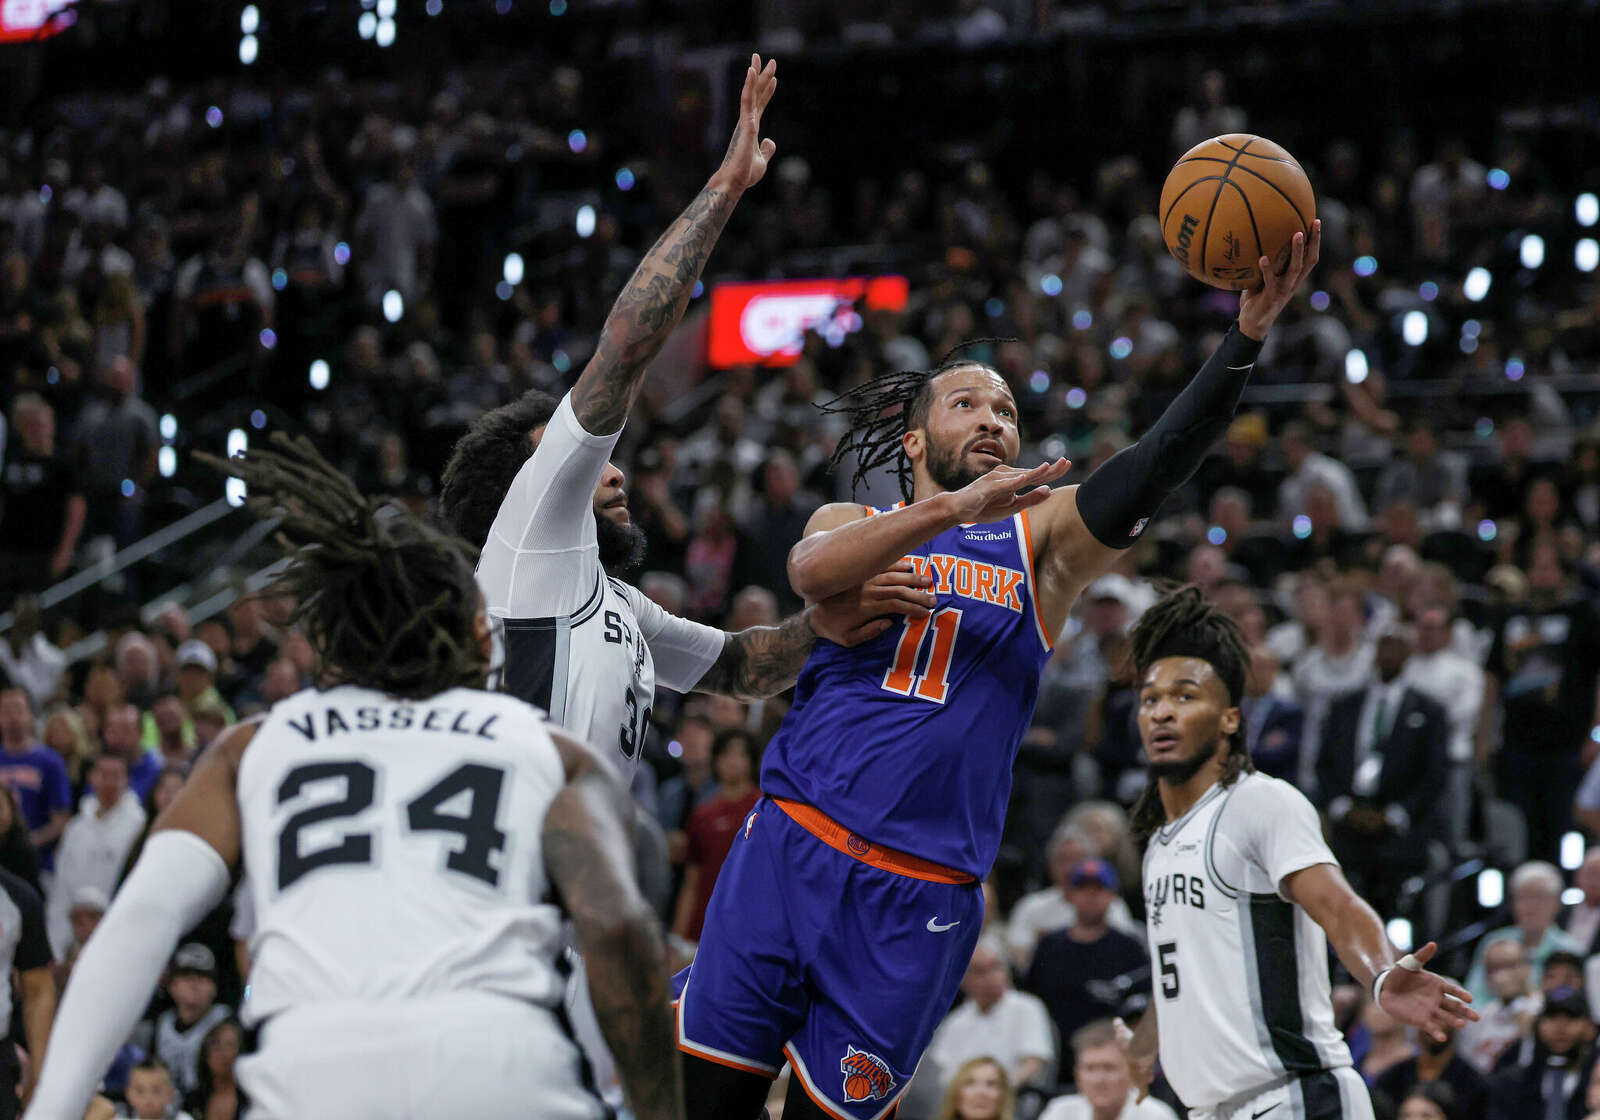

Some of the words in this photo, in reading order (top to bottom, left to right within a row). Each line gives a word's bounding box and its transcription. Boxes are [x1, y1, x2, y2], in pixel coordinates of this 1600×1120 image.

[964, 533, 983, 541] abu
[984, 529, 1012, 541] dhabi
[929, 553, 1026, 615] YORK
[880, 606, 964, 705] 11
[287, 707, 499, 742] VASSELL
[275, 759, 510, 893] 24
[1157, 942, 1180, 1000] 5
